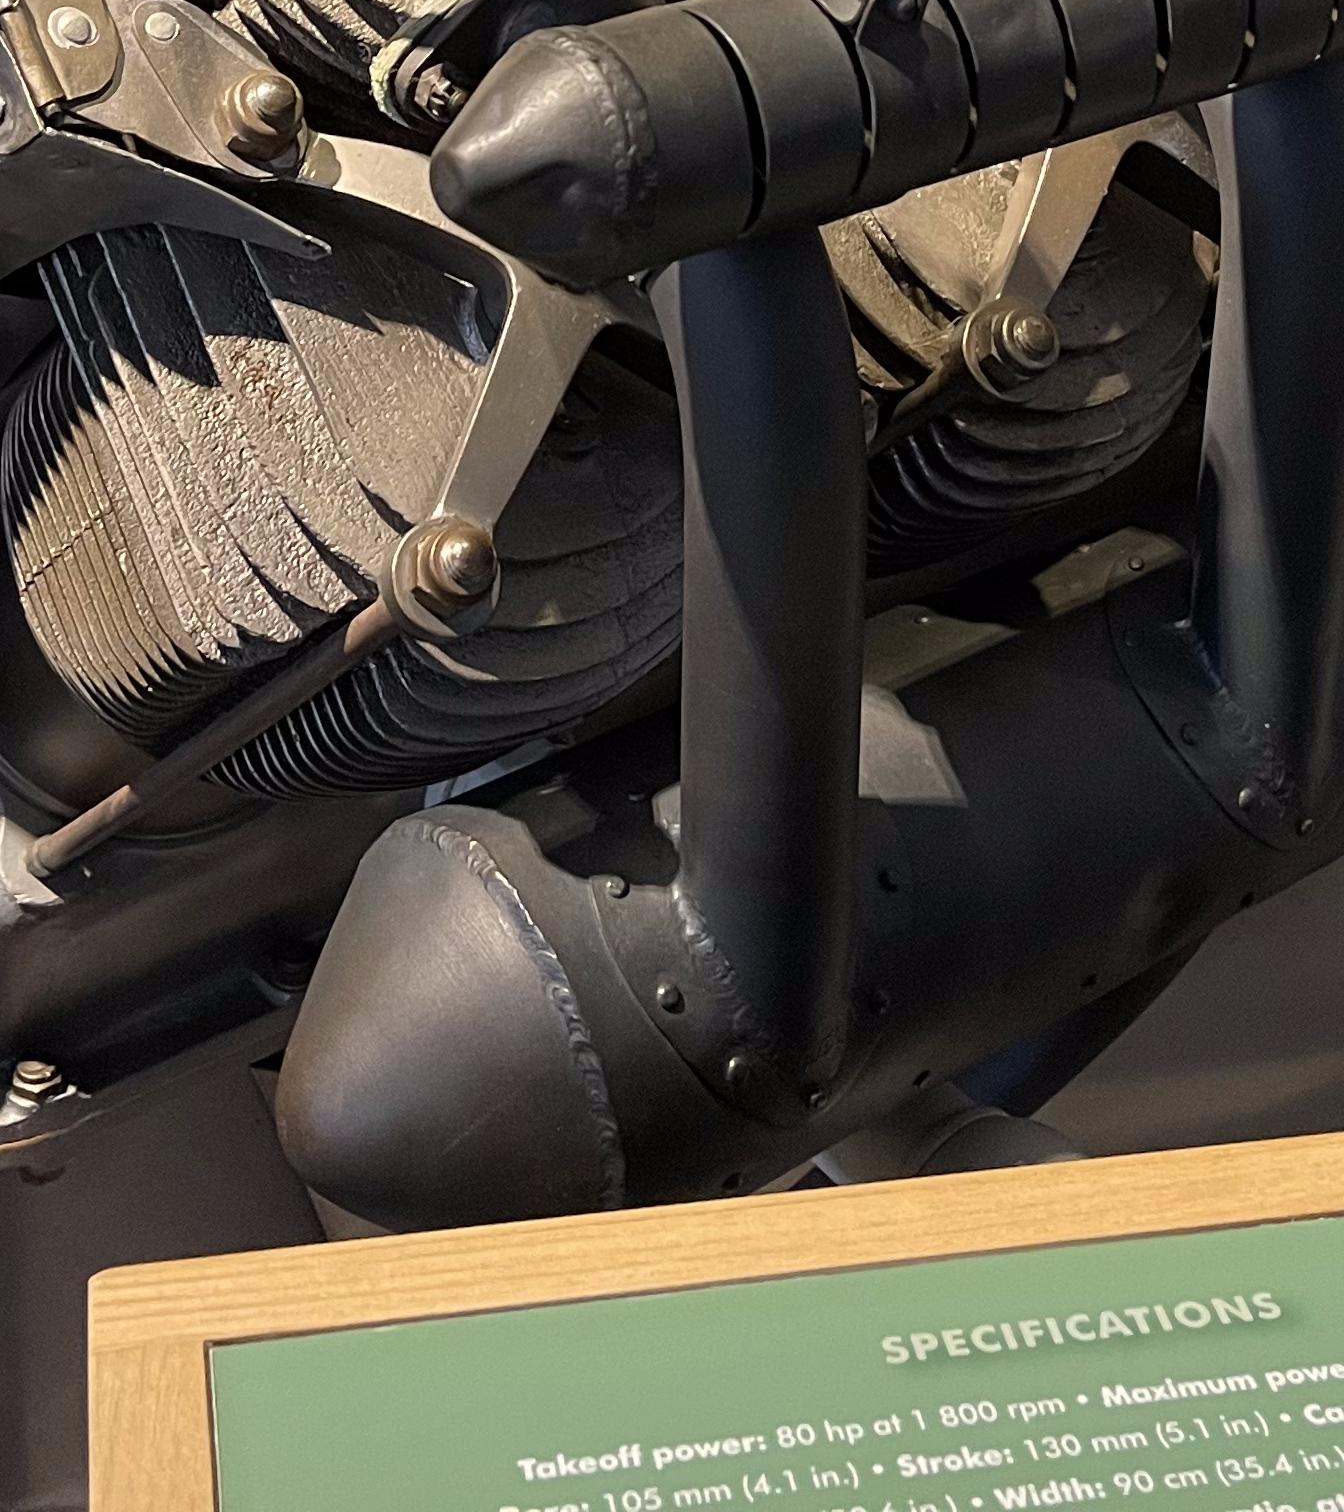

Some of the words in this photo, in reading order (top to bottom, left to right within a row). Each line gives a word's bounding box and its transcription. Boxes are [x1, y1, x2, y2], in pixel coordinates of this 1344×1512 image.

[881, 1292, 1281, 1364] SPECIFICATIONS
[516, 1443, 643, 1482] Takeoff
[651, 1435, 768, 1471] power:
[775, 1423, 816, 1449] 80
[823, 1419, 865, 1446] hp
[872, 1413, 902, 1436] at
[911, 1409, 926, 1431] 1
[938, 1400, 998, 1428] 800
[1006, 1397, 1066, 1423] rpm
[1100, 1373, 1259, 1408] Maximum
[603, 1486, 663, 1512] 105
[673, 1483, 733, 1508] mm
[742, 1469, 798, 1504] (4.1
[810, 1461, 859, 1490] in.)
[896, 1445, 1015, 1478] Stroke:
[1023, 1433, 1082, 1461] 130
[1090, 1431, 1149, 1454] mm
[1155, 1417, 1210, 1449] (5.1
[1218, 1410, 1270, 1439] in.)
[992, 1477, 1107, 1511] Width:
[1112, 1470, 1155, 1496] 90
[1163, 1469, 1209, 1490] cm
[1215, 1453, 1294, 1488] (35.4
